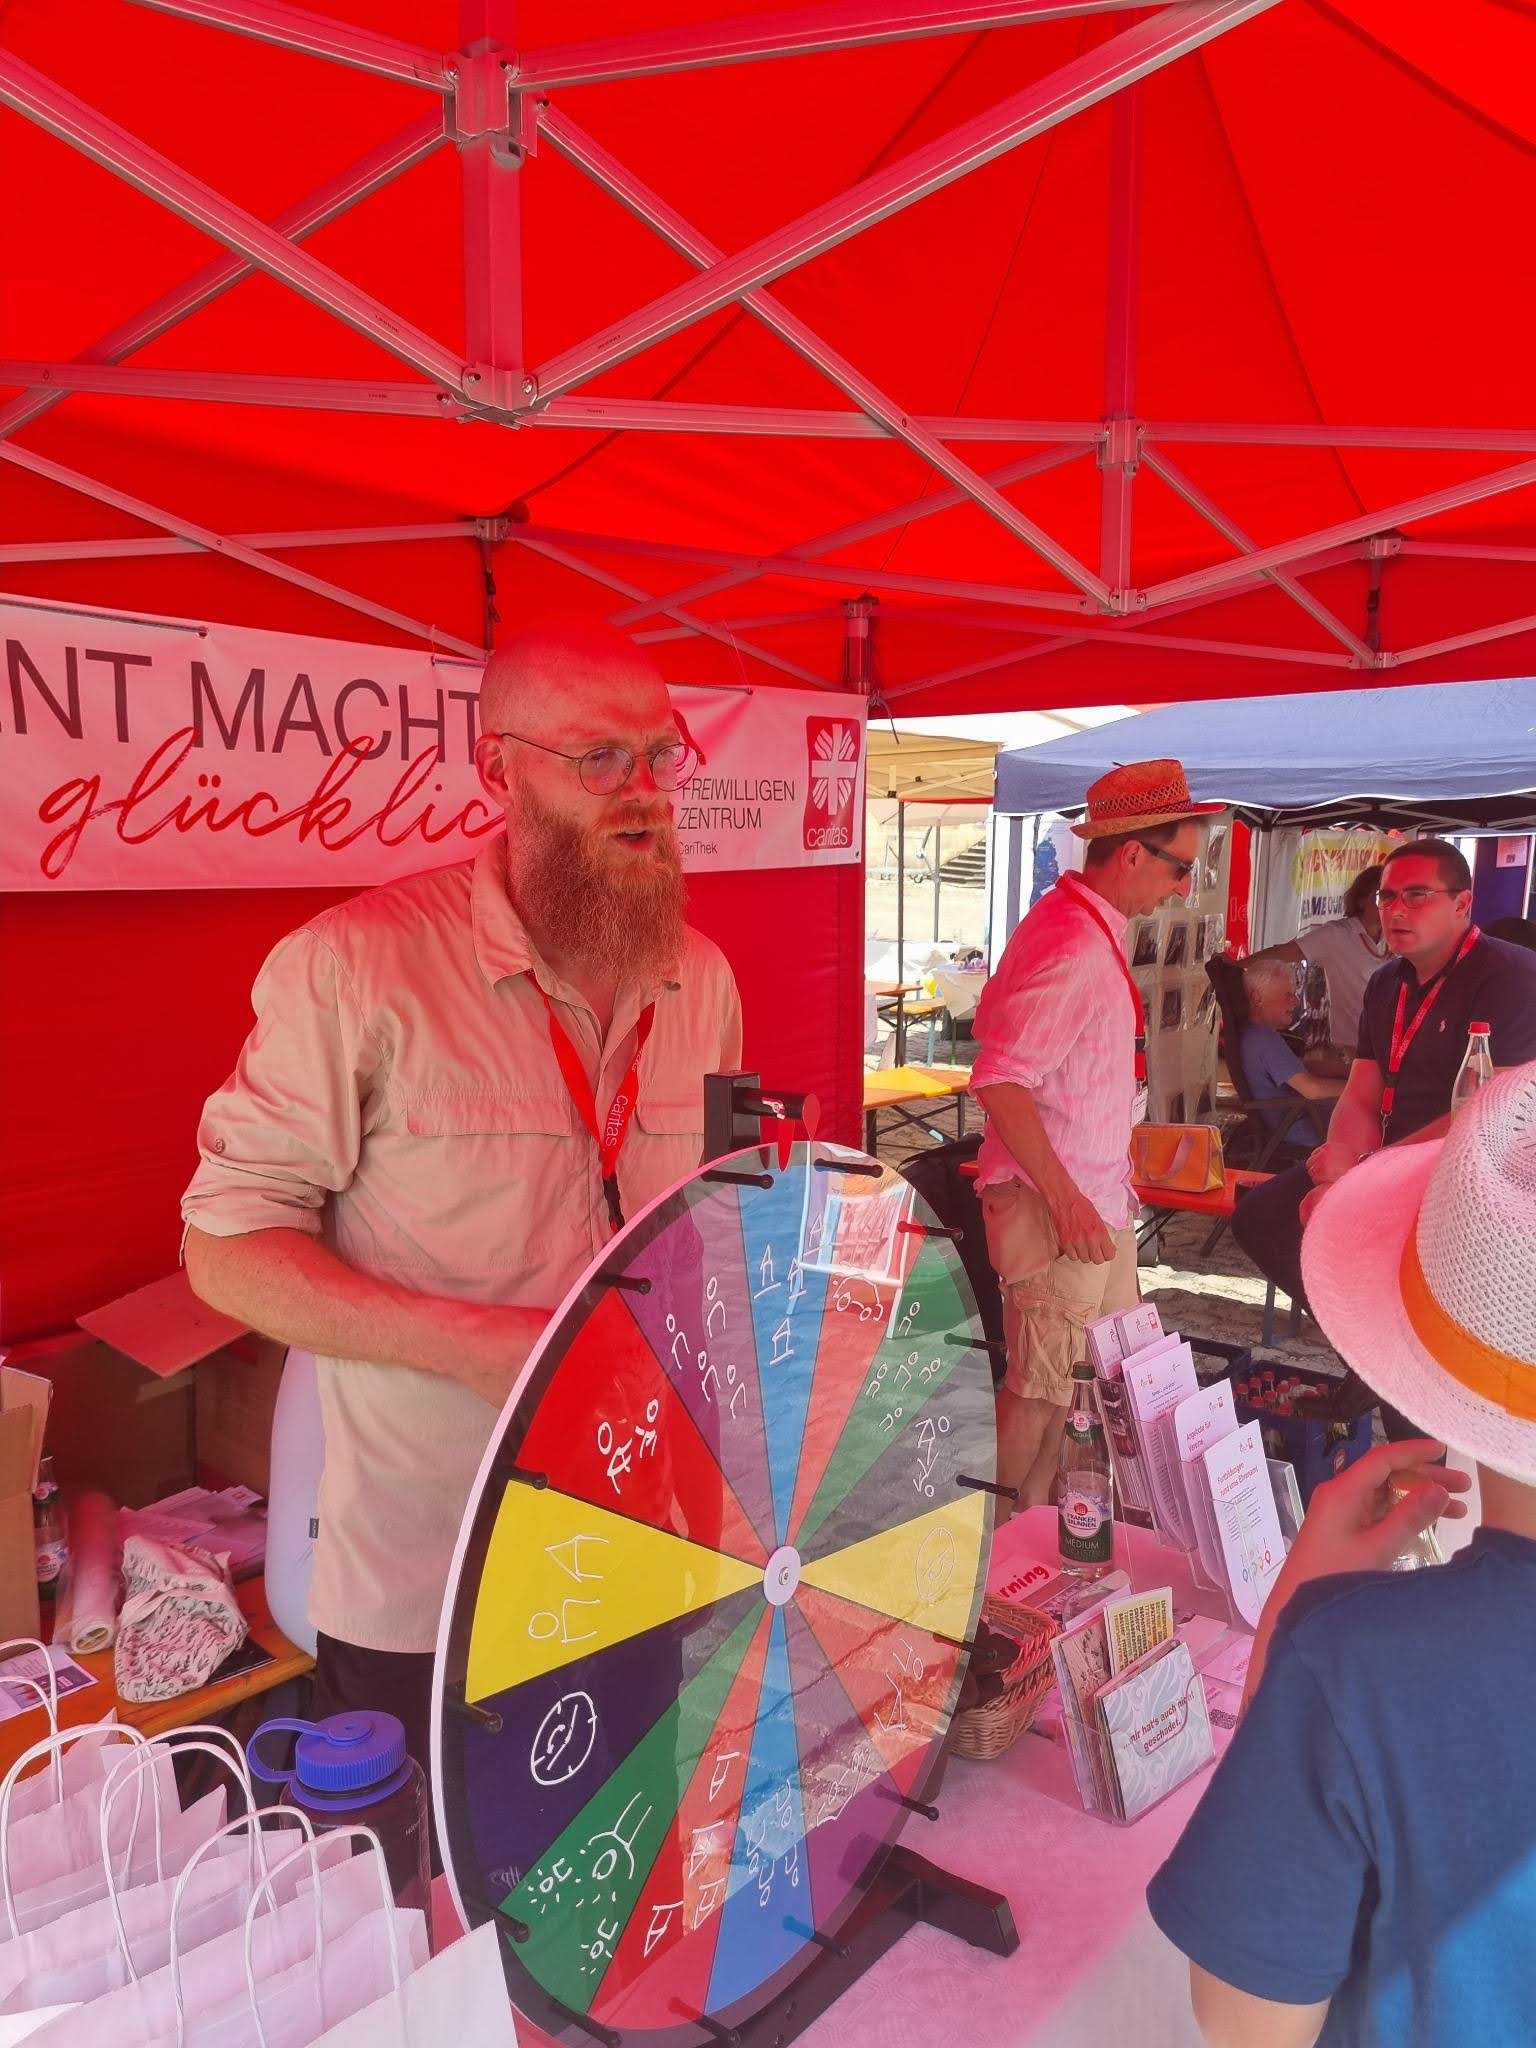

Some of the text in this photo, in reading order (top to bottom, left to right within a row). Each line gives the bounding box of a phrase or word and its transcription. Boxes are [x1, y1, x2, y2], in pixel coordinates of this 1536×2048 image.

[0, 639, 481, 765] NT MACHT
[682, 778, 795, 801] FREIWILLIGEN
[39, 727, 505, 879] glücklic
[677, 807, 762, 830] ZENTRUM
[806, 825, 848, 848] caritas
[605, 1095, 629, 1147] caritas
[1065, 1537, 1099, 1549] MEDIUM
[1000, 1566, 1050, 1598] rning
[1161, 1703, 1177, 1721] auch
